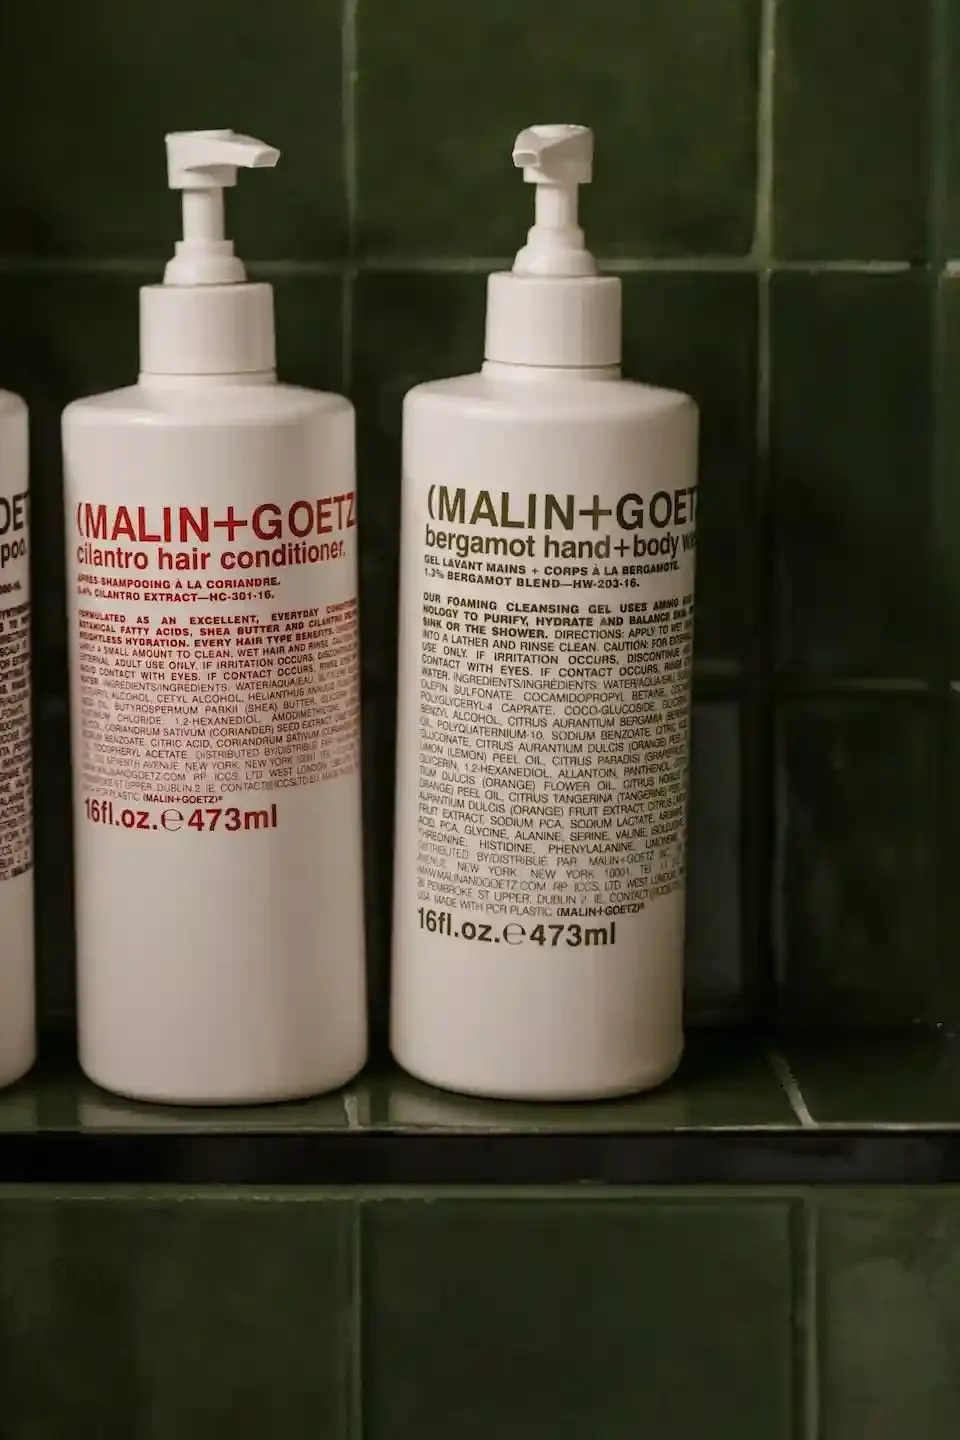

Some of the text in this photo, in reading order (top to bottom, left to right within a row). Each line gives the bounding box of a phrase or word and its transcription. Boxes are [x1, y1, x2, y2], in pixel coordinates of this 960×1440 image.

[426, 523, 534, 558] bergamot
[77, 540, 345, 570] cilantro hair conditioner.
[425, 554, 440, 565] GEL
[443, 558, 483, 571] LAVANT
[487, 563, 526, 575] MAINS
[544, 566, 588, 576] CORPS
[604, 566, 618, 575] LA
[188, 580, 202, 589] LA
[206, 577, 280, 589] CORIANDRE.
[448, 571, 511, 586] BERGAMOT
[424, 592, 440, 603] OUR
[448, 596, 497, 610] FOAMING
[507, 602, 580, 614] CLEANSING
[588, 604, 612, 614] GEL
[620, 602, 647, 613] USES
[137, 616, 149, 624] AS
[161, 616, 176, 625] AN
[271, 608, 319, 621] EVERYDAY
[464, 611, 478, 621] TO
[536, 617, 593, 627] HYDRATE
[600, 616, 624, 626] AND
[121, 626, 149, 636] FATTY
[199, 627, 231, 636] SHEA
[237, 624, 279, 635] BUTTER
[285, 622, 304, 632] AND
[446, 621, 460, 631] OR
[465, 623, 486, 634] THE
[492, 627, 548, 639] SHOWER.
[126, 633, 292, 647] HYDRATION. EVERY HAIR TYPE
[452, 635, 555, 651] LATHER AND RINSE
[132, 650, 173, 659] AMOUNT
[176, 650, 191, 659] TO
[238, 648, 259, 657] WET
[263, 644, 285, 655] HAIR
[477, 650, 558, 664] IF IRRITATION
[146, 660, 164, 670] USE
[203, 661, 213, 670] IF
[217, 657, 273, 670] IRRITATION
[467, 662, 493, 673] WITH
[541, 667, 551, 676] IF
[559, 667, 612, 678] CONTACT
[141, 671, 165, 681] WITH
[171, 672, 200, 681] EYES.
[208, 671, 217, 680] IF
[223, 669, 273, 681] CONTACT
